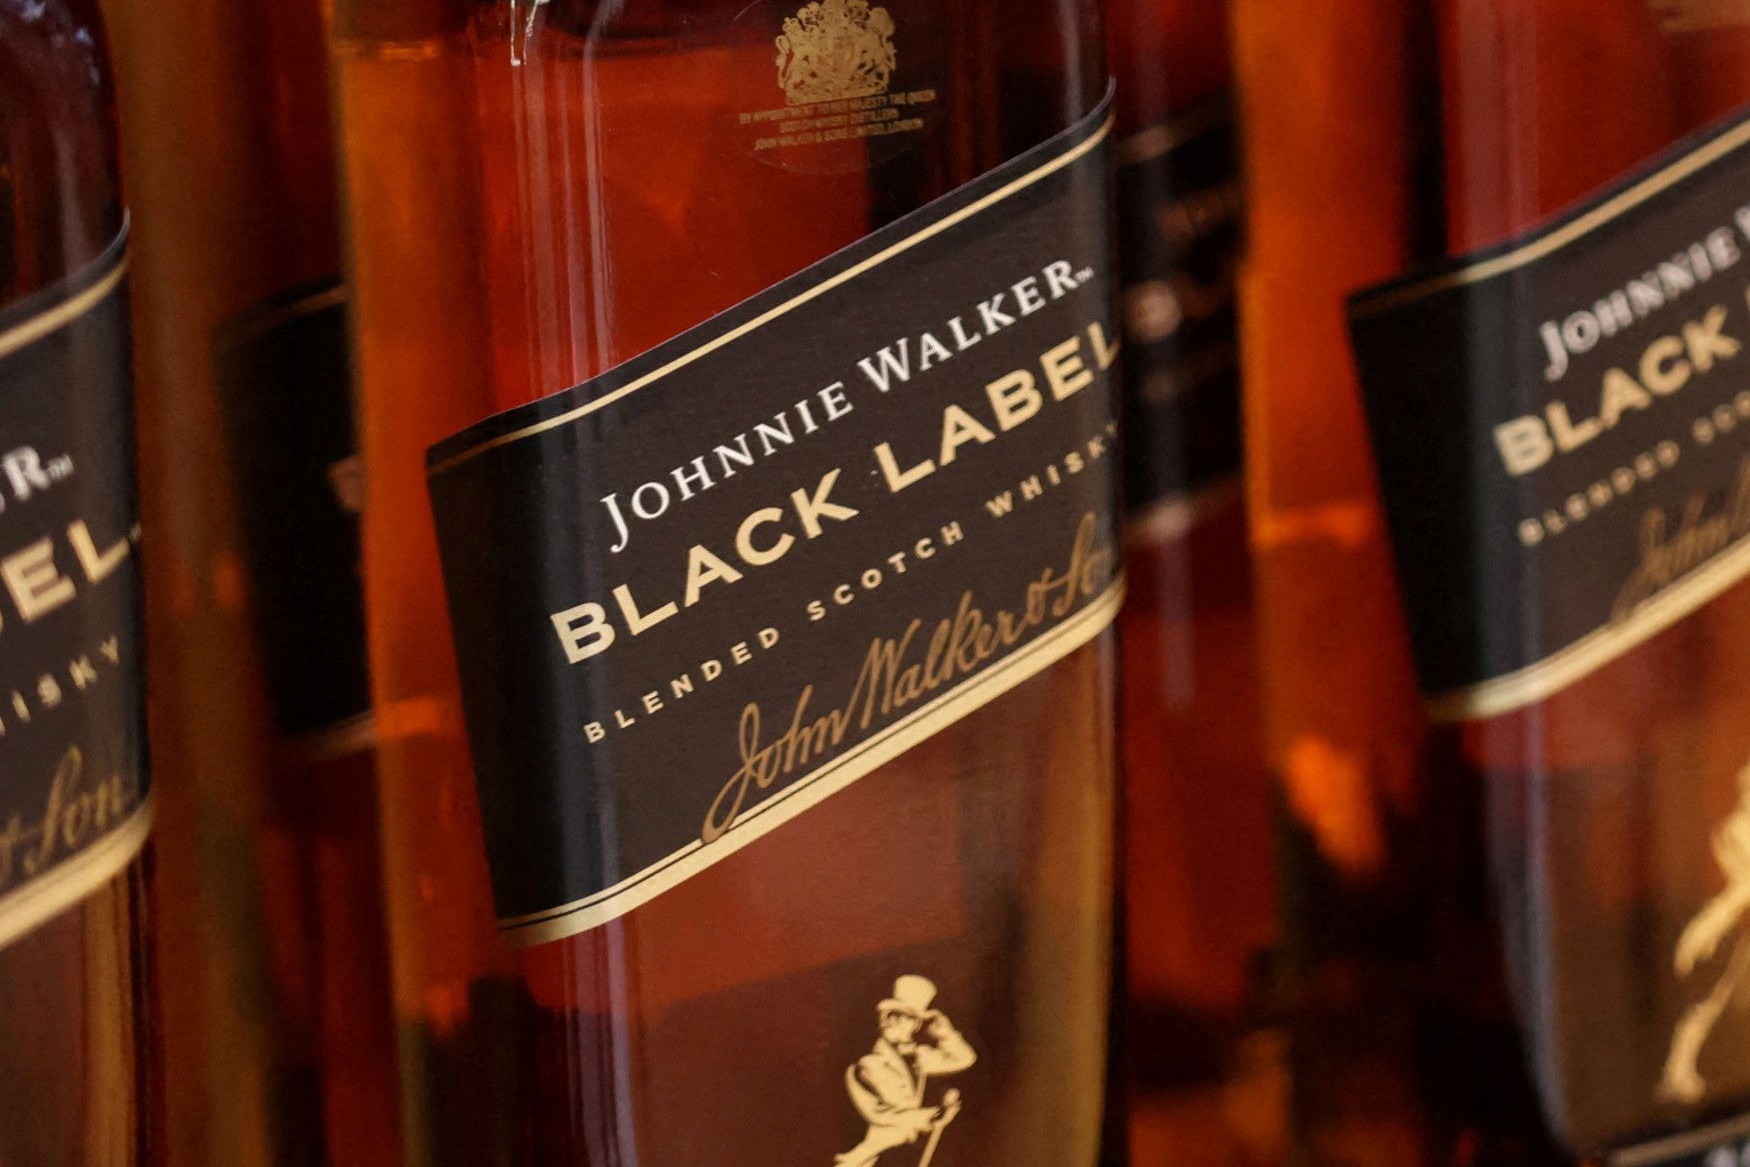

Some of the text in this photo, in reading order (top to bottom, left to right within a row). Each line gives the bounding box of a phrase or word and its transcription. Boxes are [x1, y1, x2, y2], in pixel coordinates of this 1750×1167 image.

[1494, 303, 1742, 477] BLACK
[1539, 227, 1741, 381] JOHNNIE
[550, 321, 1120, 664] BLACK LABEL
[600, 382, 852, 553] JOHNNIE
[584, 627, 780, 742] BLENDED
[806, 521, 964, 622] SCOTCH
[702, 684, 843, 844] John
